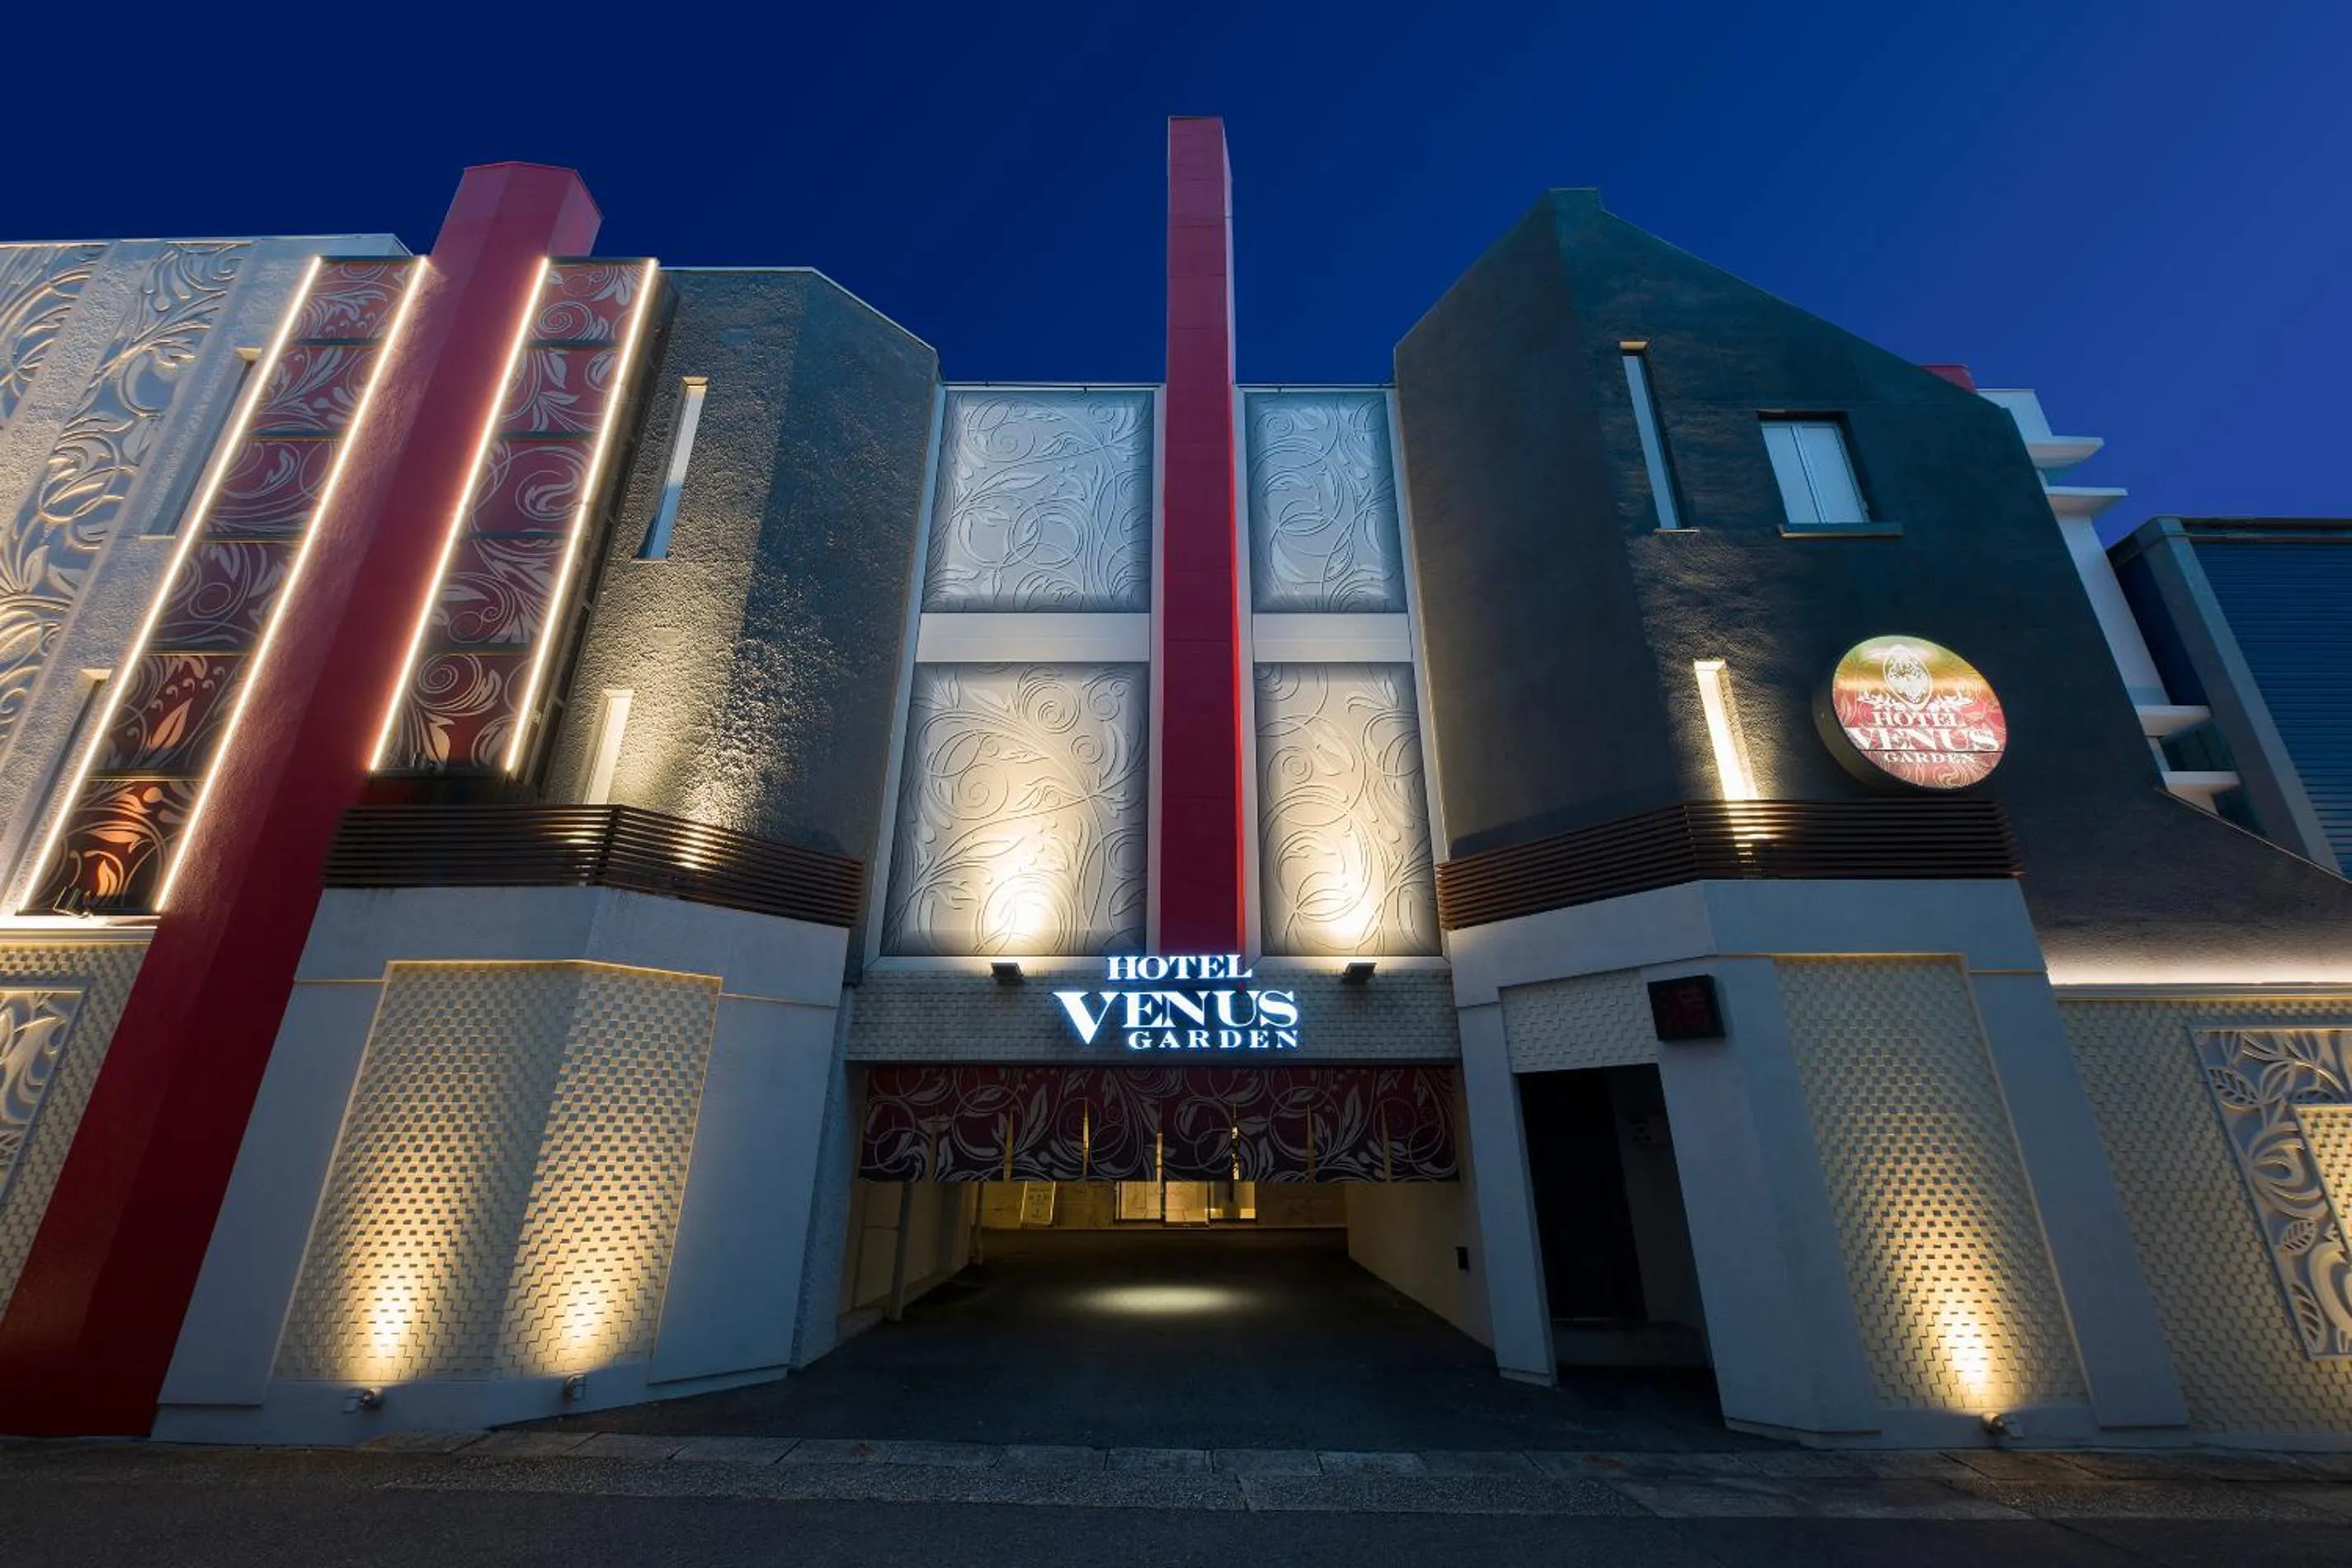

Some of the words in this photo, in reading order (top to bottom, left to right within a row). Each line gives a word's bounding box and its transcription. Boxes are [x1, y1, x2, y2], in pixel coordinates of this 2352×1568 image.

[1872, 712, 1967, 727] HOTEL
[1844, 727, 2000, 751] VENUS
[1884, 752, 1977, 763] GARDEN
[1107, 954, 1252, 980] HOTEL
[1053, 990, 1299, 1045] VENUS
[1129, 1029, 1298, 1050] GARDEN
